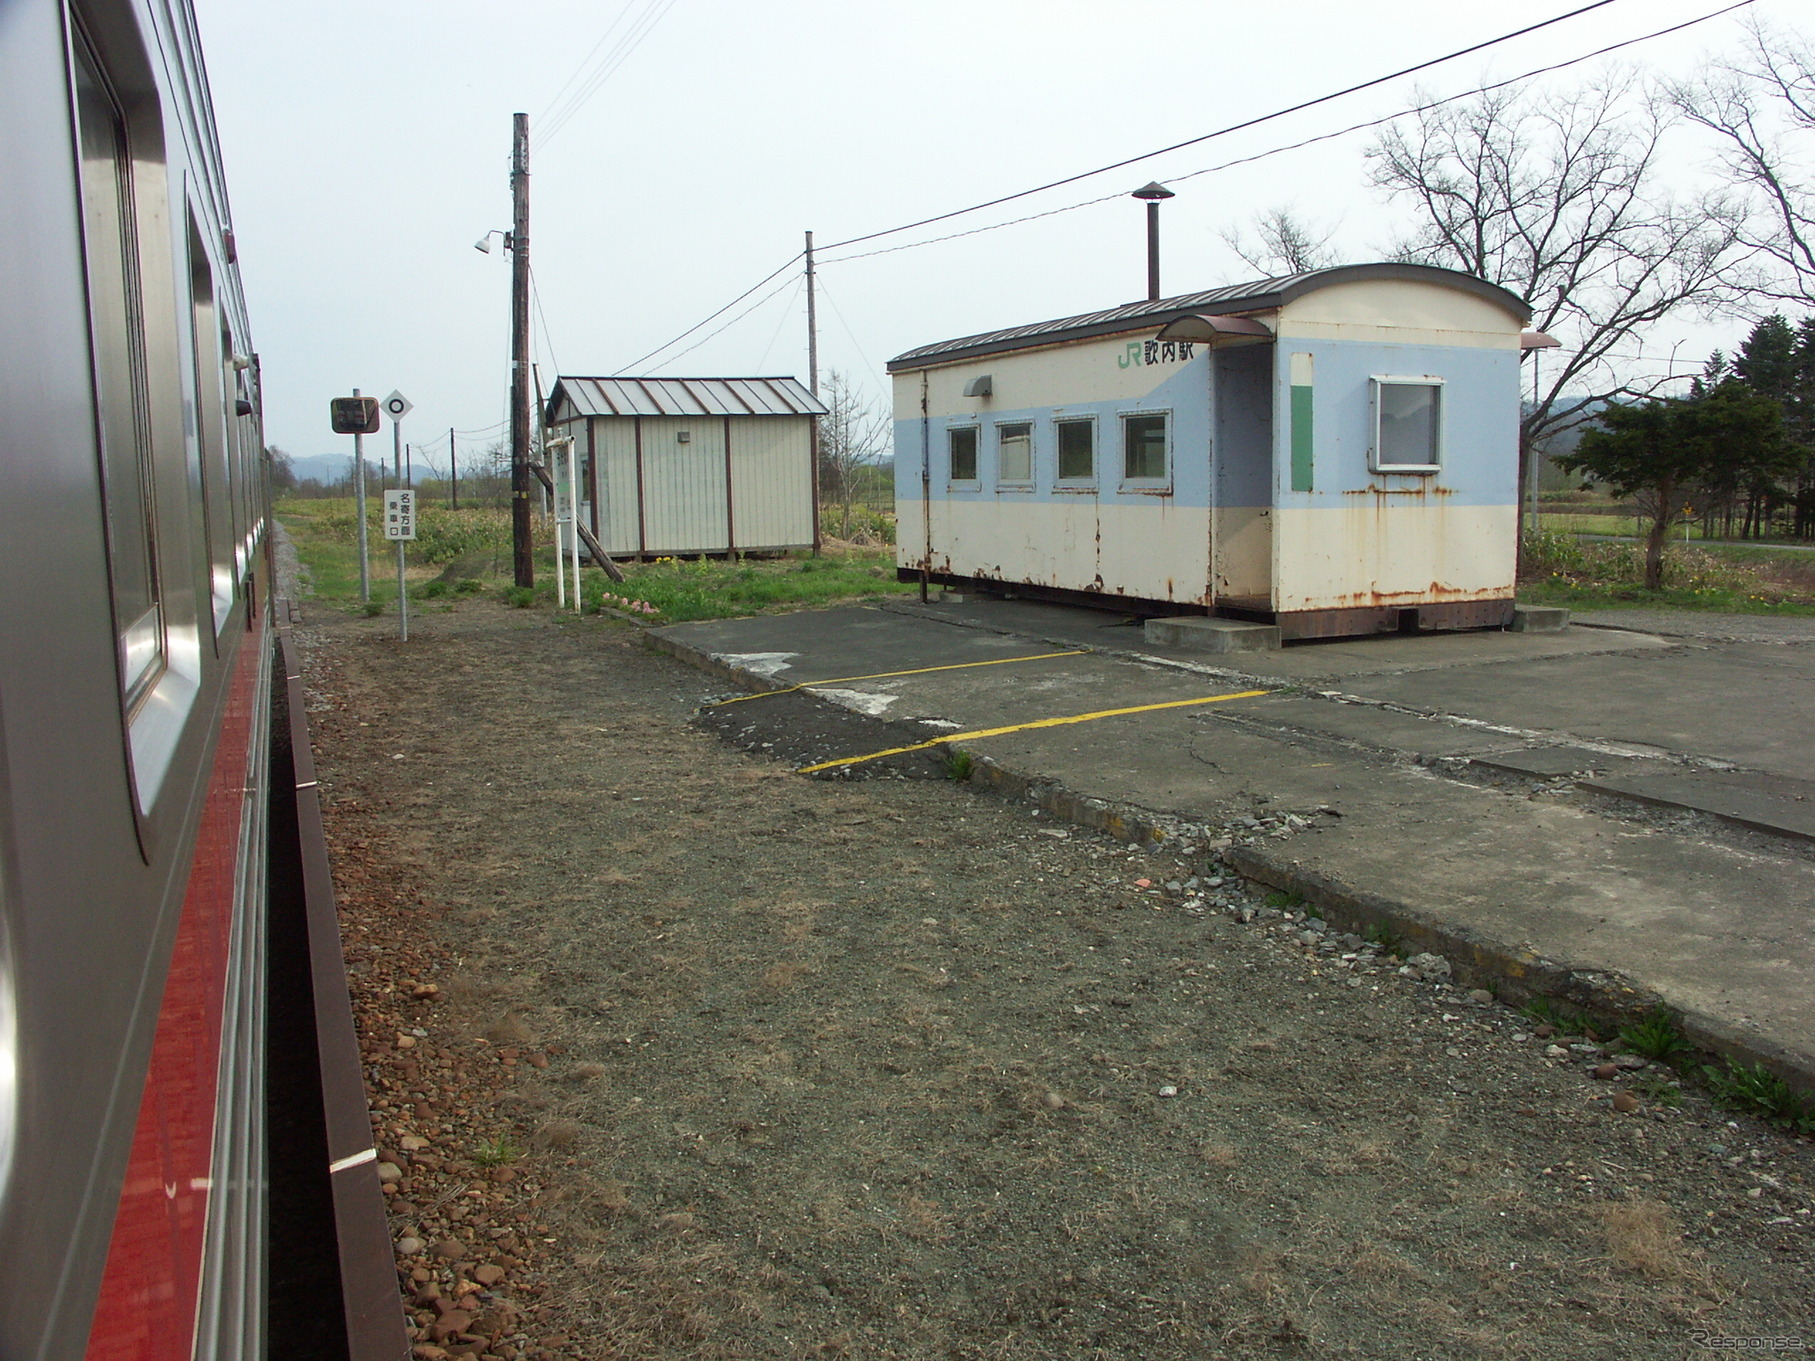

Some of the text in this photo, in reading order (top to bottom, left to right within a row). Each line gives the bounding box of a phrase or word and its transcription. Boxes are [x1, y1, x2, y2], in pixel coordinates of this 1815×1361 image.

[1118, 340, 1194, 369] JR 歌内駅
[401, 493, 410, 536] 名寄方面
